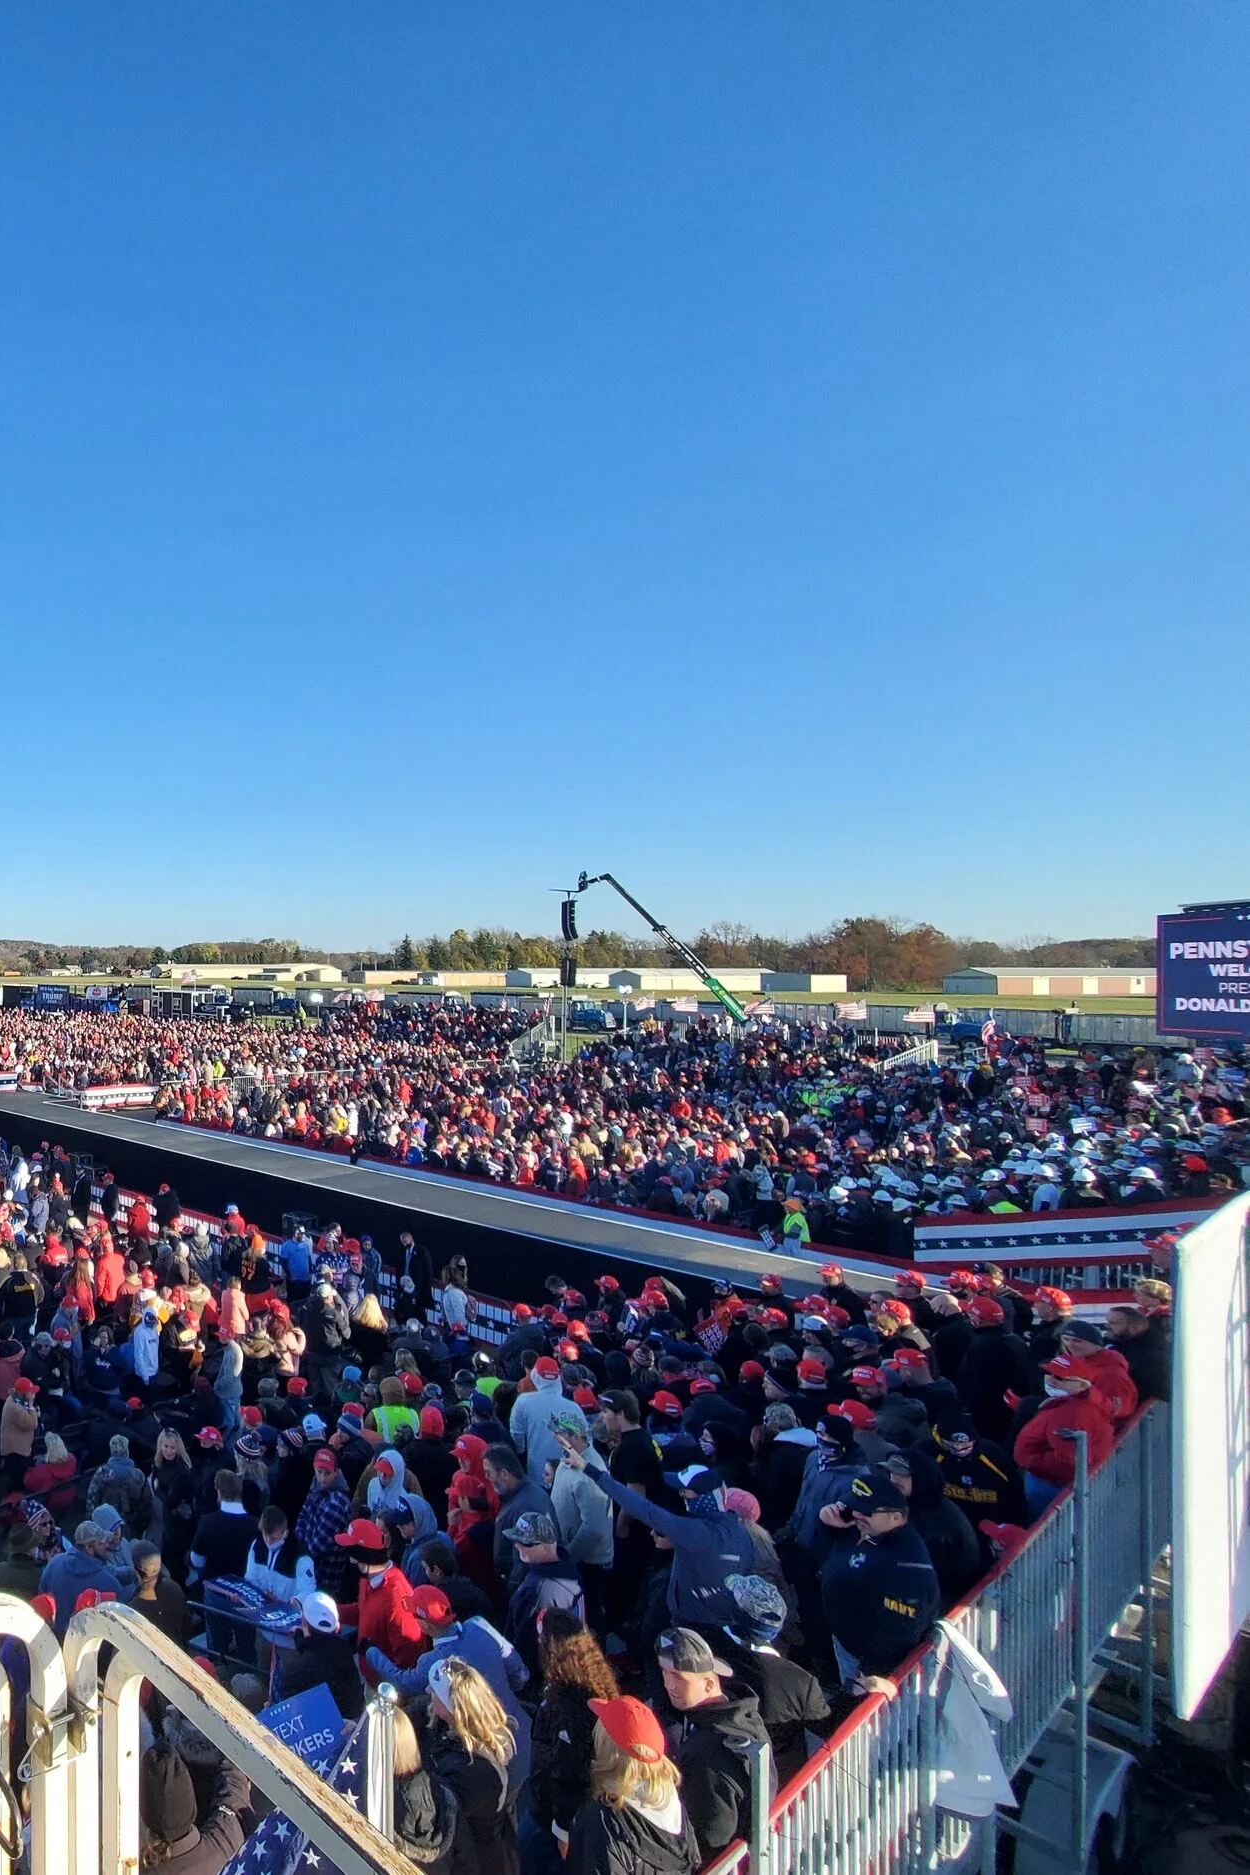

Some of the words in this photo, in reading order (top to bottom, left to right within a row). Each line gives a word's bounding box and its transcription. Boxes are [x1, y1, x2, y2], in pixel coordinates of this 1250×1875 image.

[1170, 940, 1250, 959] PENNS
[1209, 964, 1250, 976] WEL
[1218, 982, 1250, 994] PRE
[1175, 998, 1250, 1013] DONALD
[884, 1597, 917, 1619] NAVY
[272, 1714, 304, 1739] TEXT
